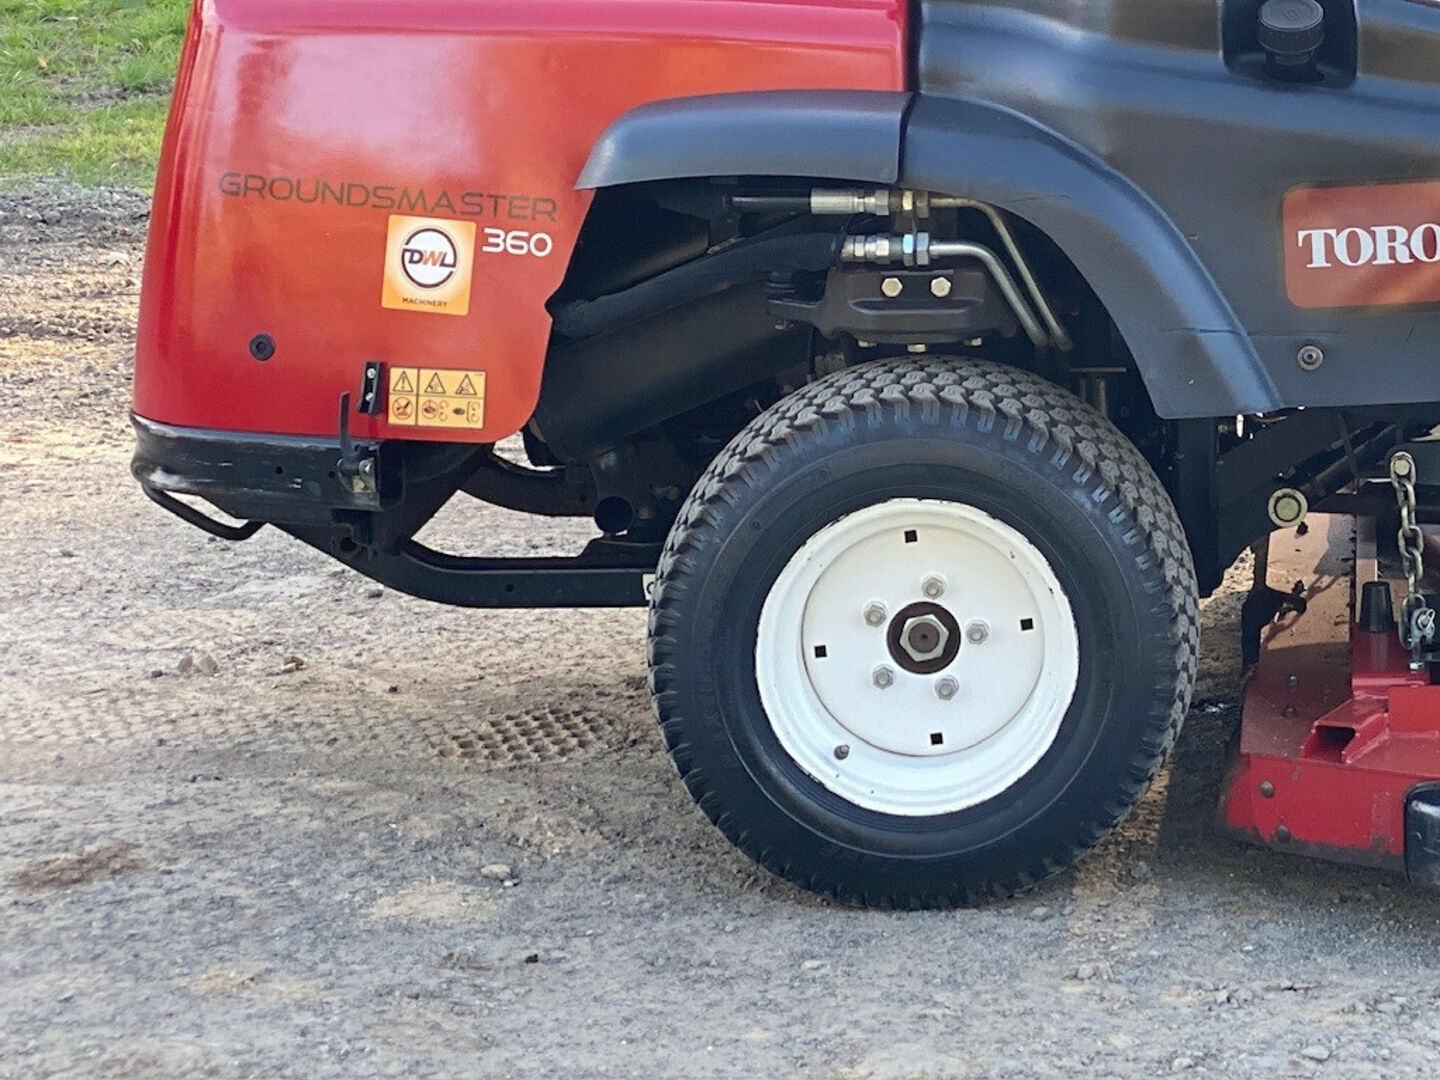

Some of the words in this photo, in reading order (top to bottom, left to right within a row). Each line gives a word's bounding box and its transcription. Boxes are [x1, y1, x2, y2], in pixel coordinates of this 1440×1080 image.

[218, 171, 557, 222] GROUNDSMASTER
[481, 227, 553, 258] 360
[407, 248, 455, 268] DWL
[401, 296, 448, 308] MACHINERY
